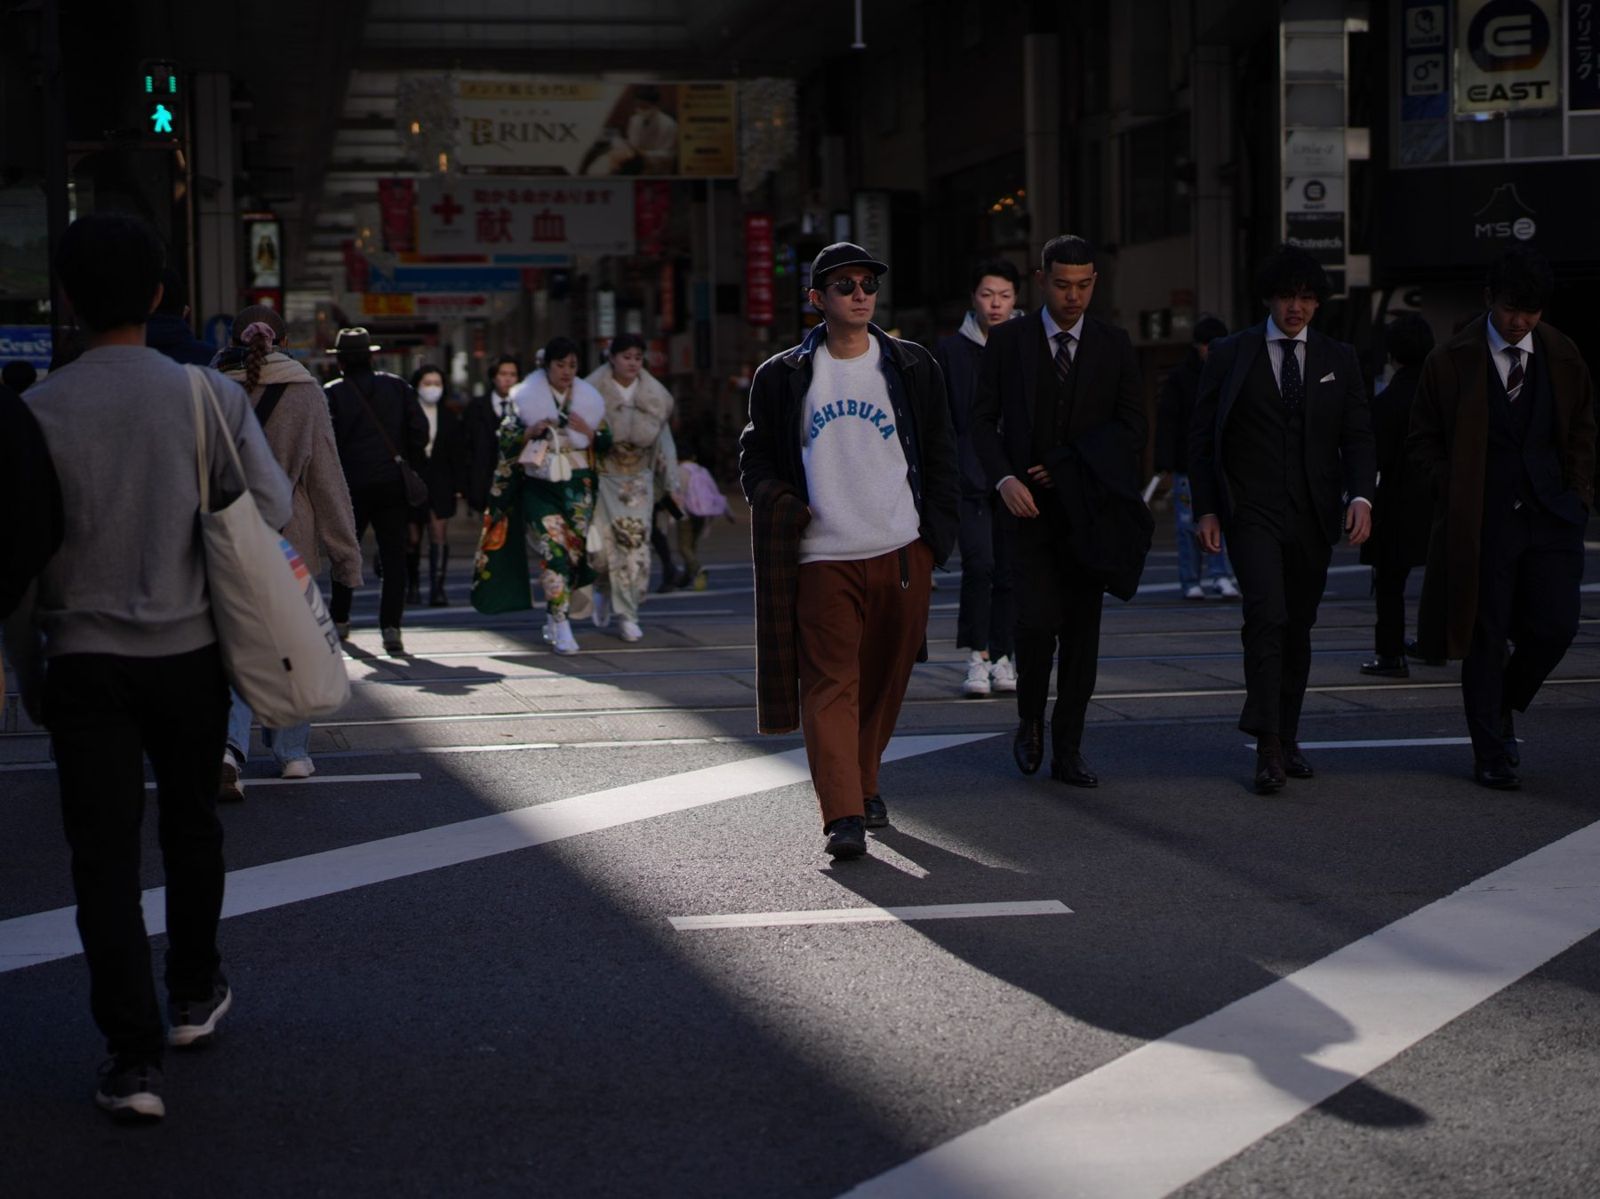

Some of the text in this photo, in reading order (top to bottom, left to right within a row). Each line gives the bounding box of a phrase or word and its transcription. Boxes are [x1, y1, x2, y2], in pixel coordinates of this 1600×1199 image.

[1576, 3, 1593, 80] クリニック
[1467, 81, 1549, 102] EAST
[475, 207, 567, 243] 献血
